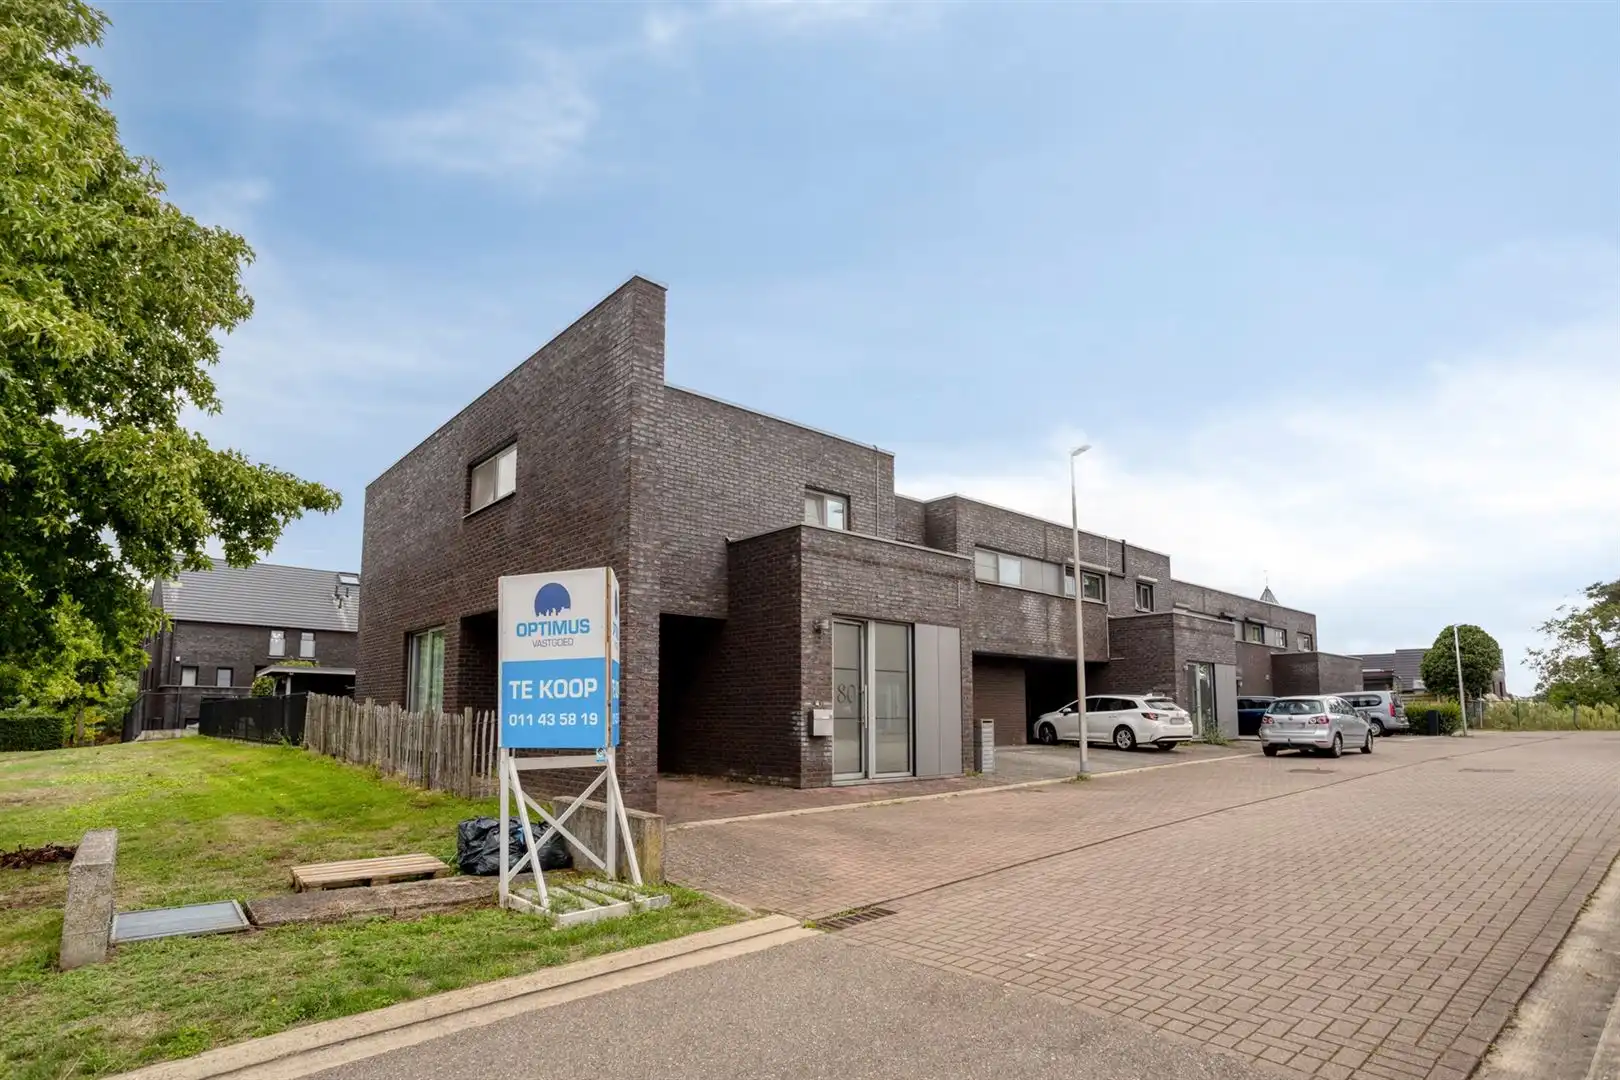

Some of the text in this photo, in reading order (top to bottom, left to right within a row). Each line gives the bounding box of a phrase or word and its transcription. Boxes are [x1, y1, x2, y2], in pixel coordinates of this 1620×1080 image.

[516, 619, 590, 637] OPTIMUS
[532, 638, 574, 648] VASTGOED
[509, 680, 533, 699] TE
[539, 678, 598, 698] KOOP
[837, 684, 855, 704] 80
[509, 714, 533, 726] 011
[538, 713, 556, 726] 43
[559, 713, 576, 725] 58
[581, 712, 598, 725] 19
